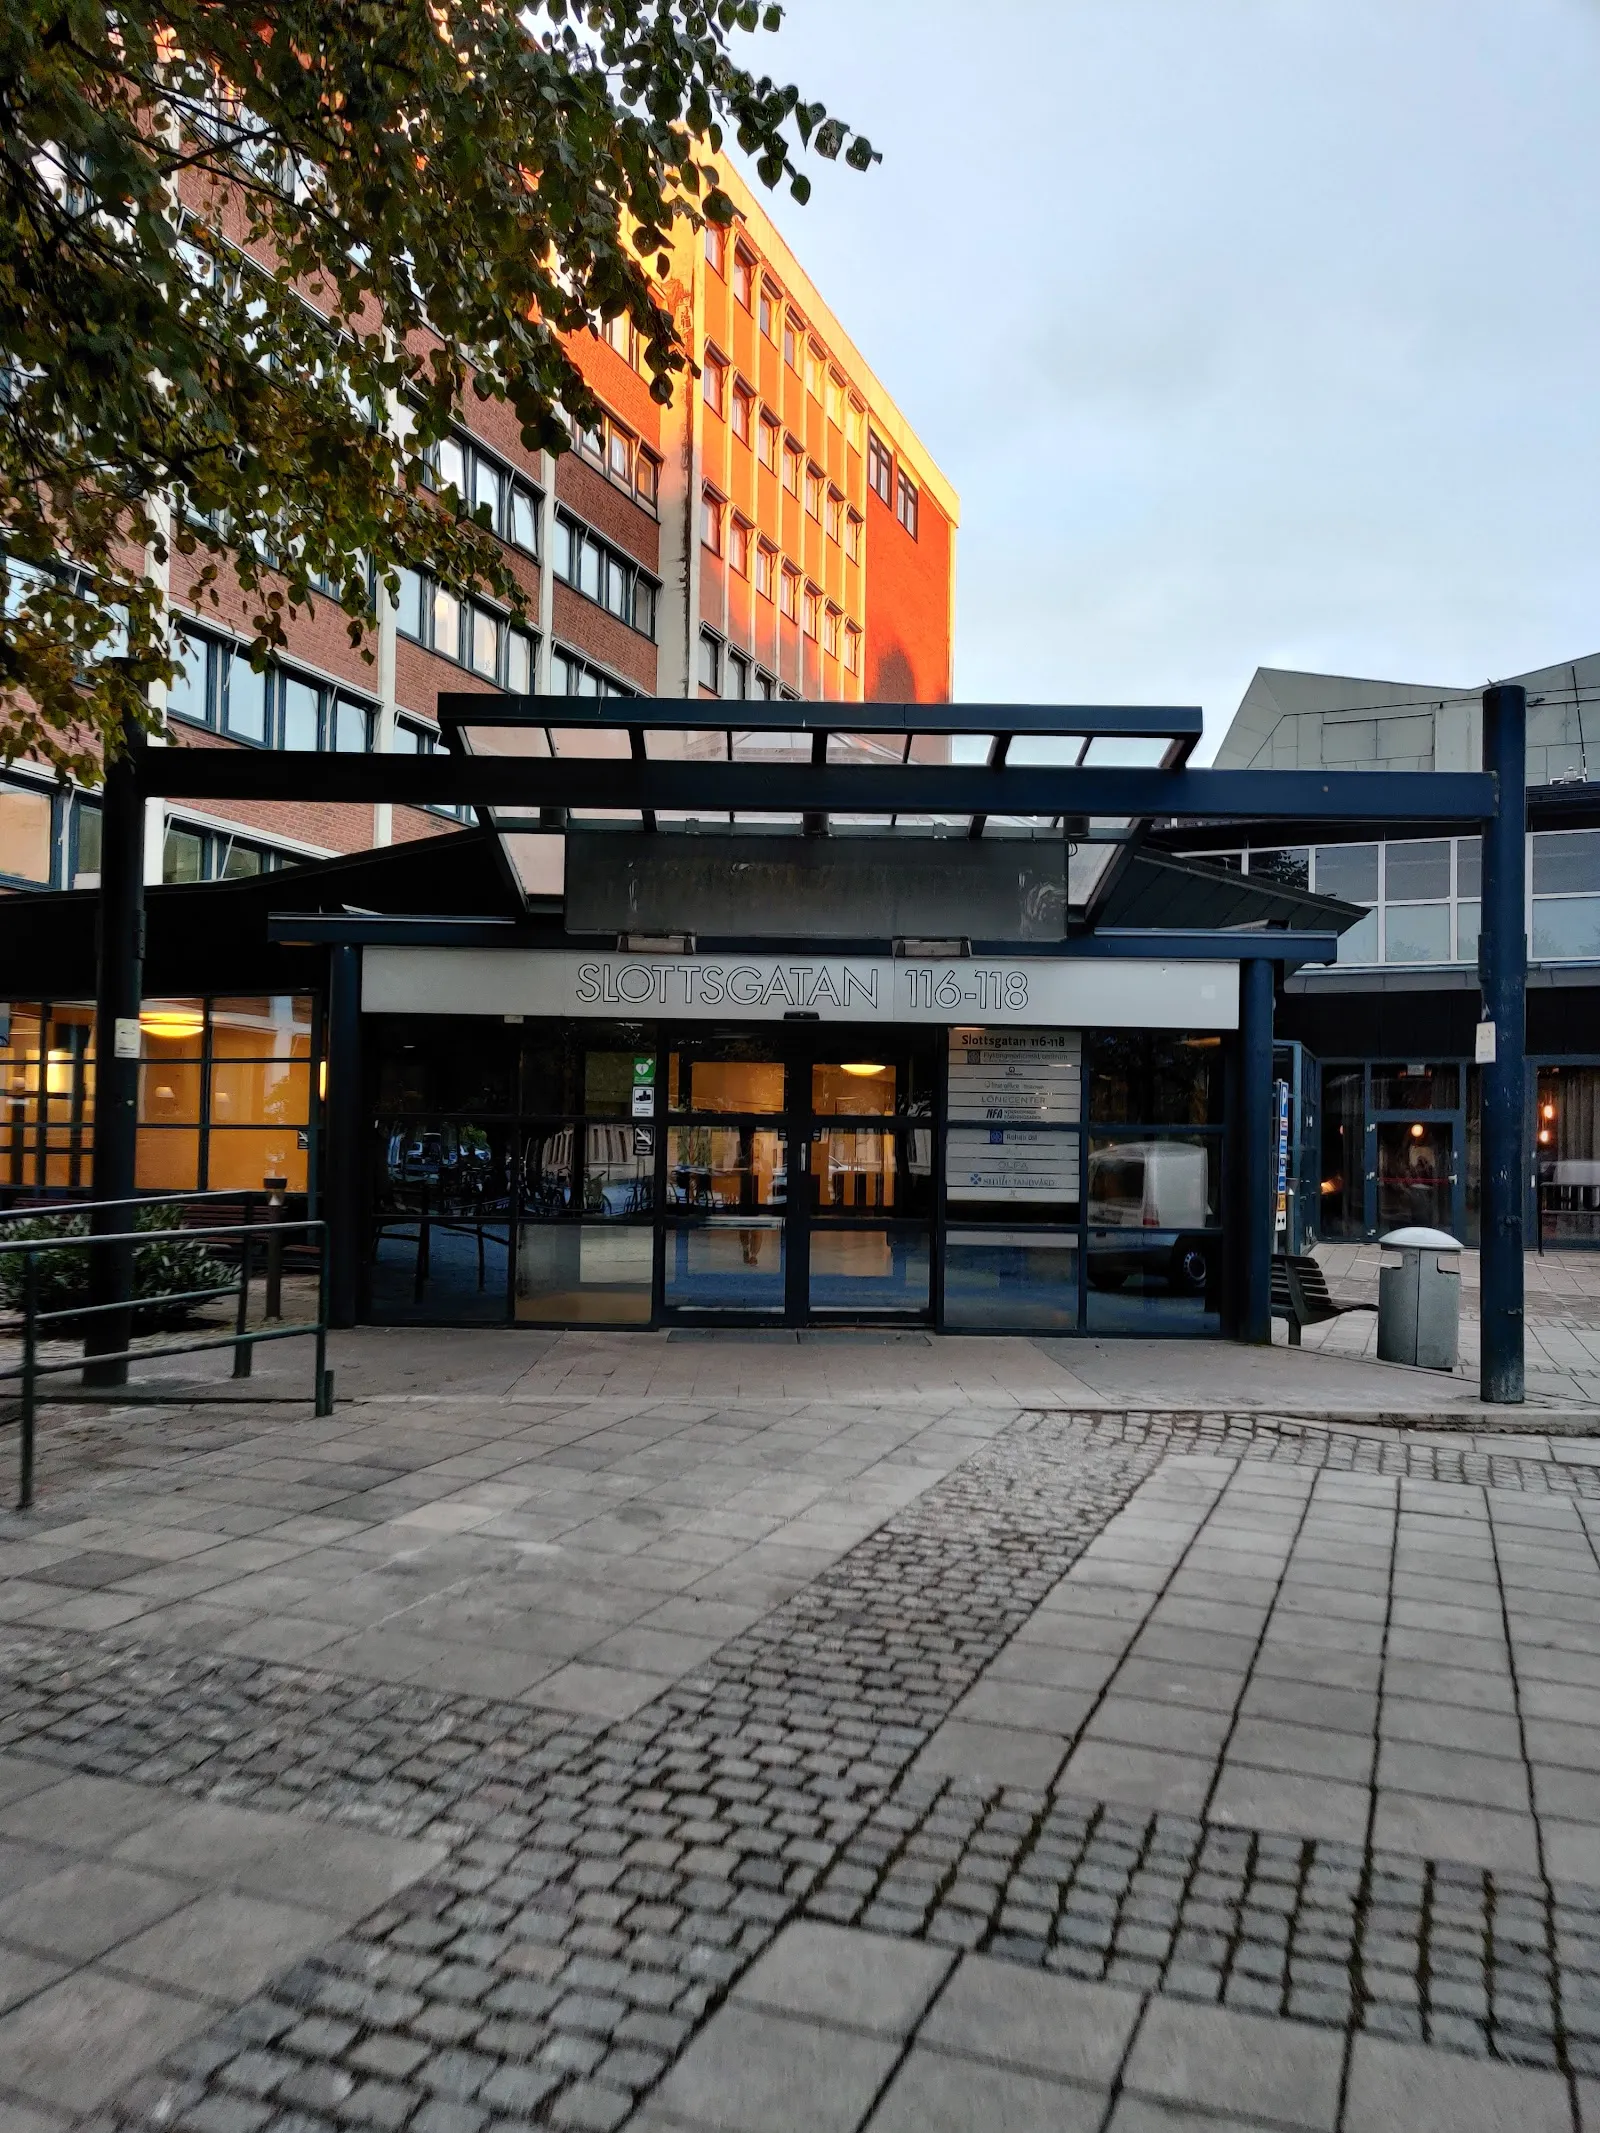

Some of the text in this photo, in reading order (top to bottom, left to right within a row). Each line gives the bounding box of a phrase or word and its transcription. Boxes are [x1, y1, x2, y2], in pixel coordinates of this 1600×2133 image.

[576, 963, 1029, 1011] SLOTTSGATAN 116-118
[962, 1034, 1065, 1048] Slottsgatan 116-118
[986, 1108, 1003, 1119] NFA
